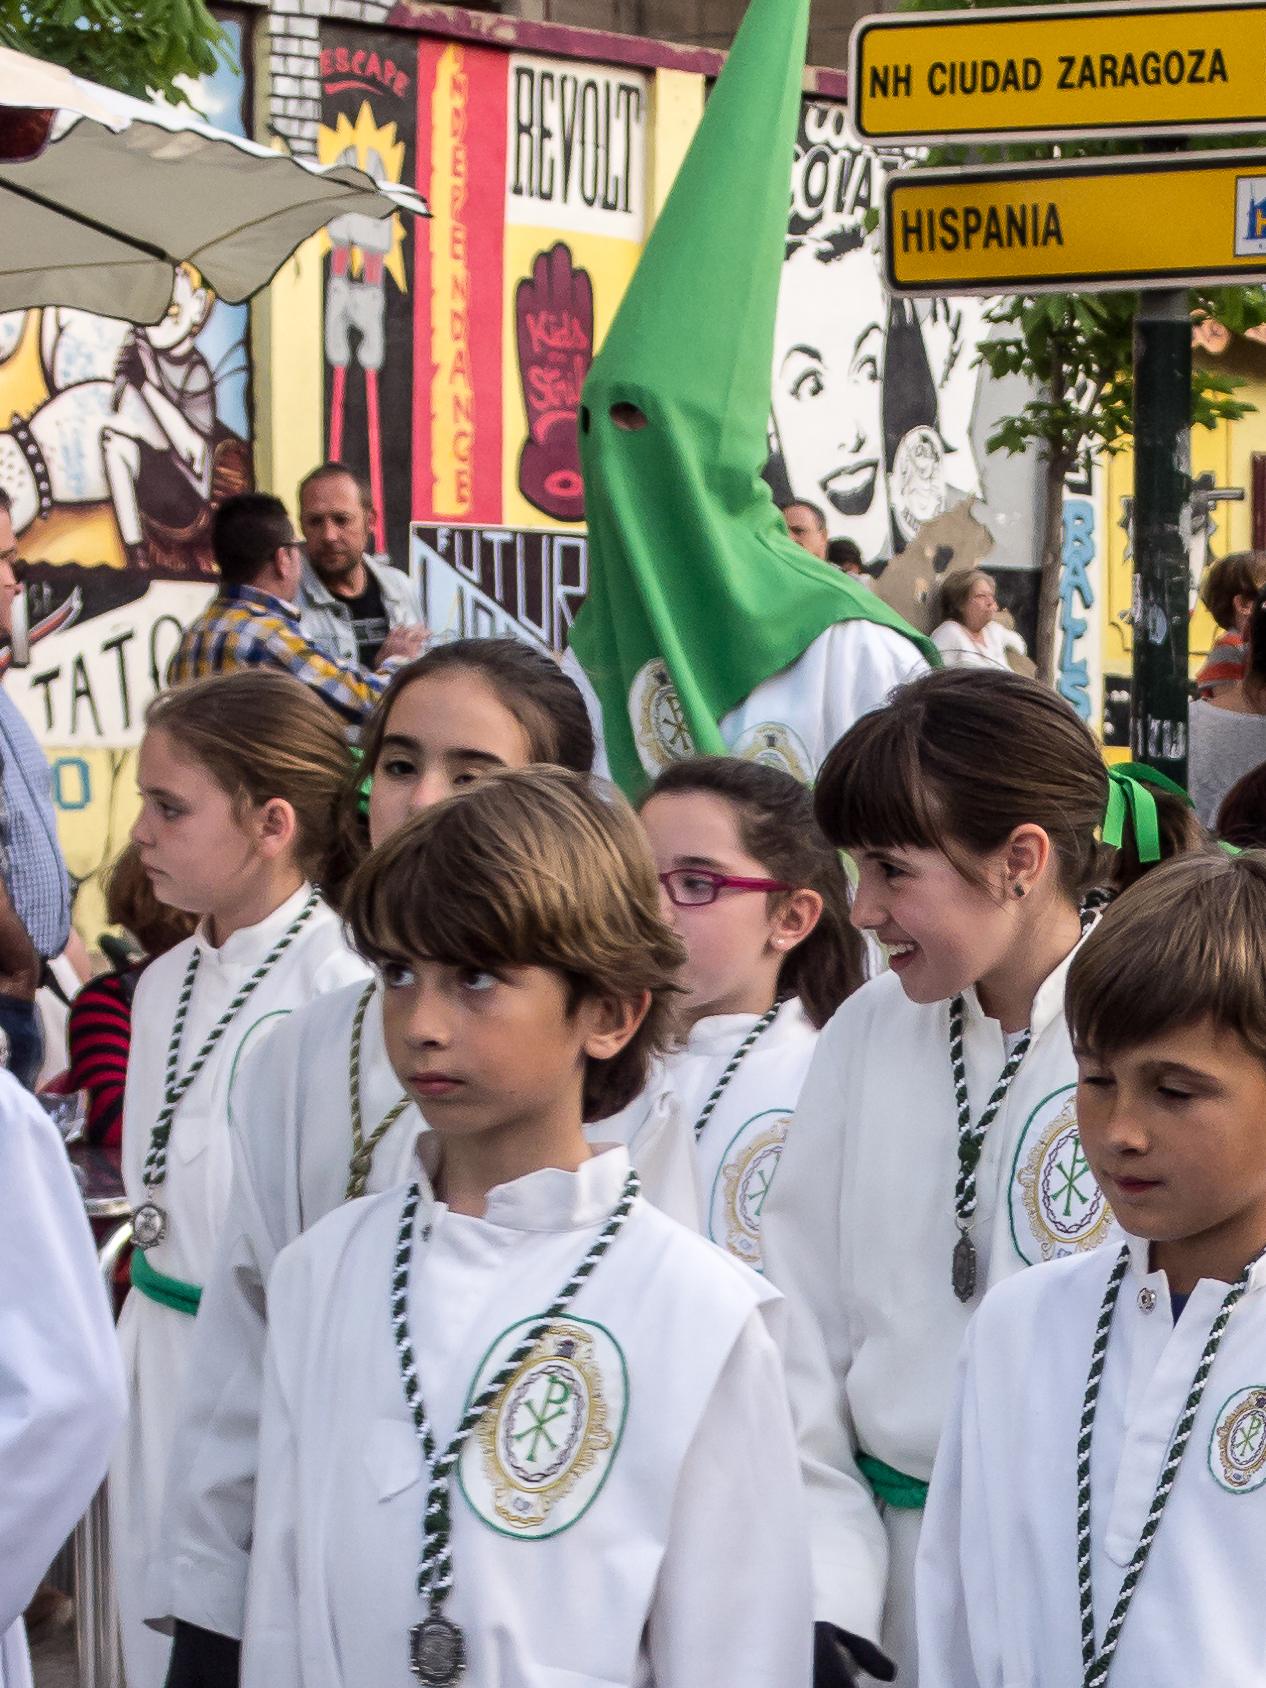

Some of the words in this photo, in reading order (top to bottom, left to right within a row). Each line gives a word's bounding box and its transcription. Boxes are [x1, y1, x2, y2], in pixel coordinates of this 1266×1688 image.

[320, 46, 411, 99] ESCAPE
[869, 64, 912, 98] NH
[927, 57, 1042, 96] CIUDAD
[1056, 48, 1229, 90] ZARAGOZA
[511, 66, 641, 213] REVOLT
[900, 202, 1065, 253] HISPANIA
